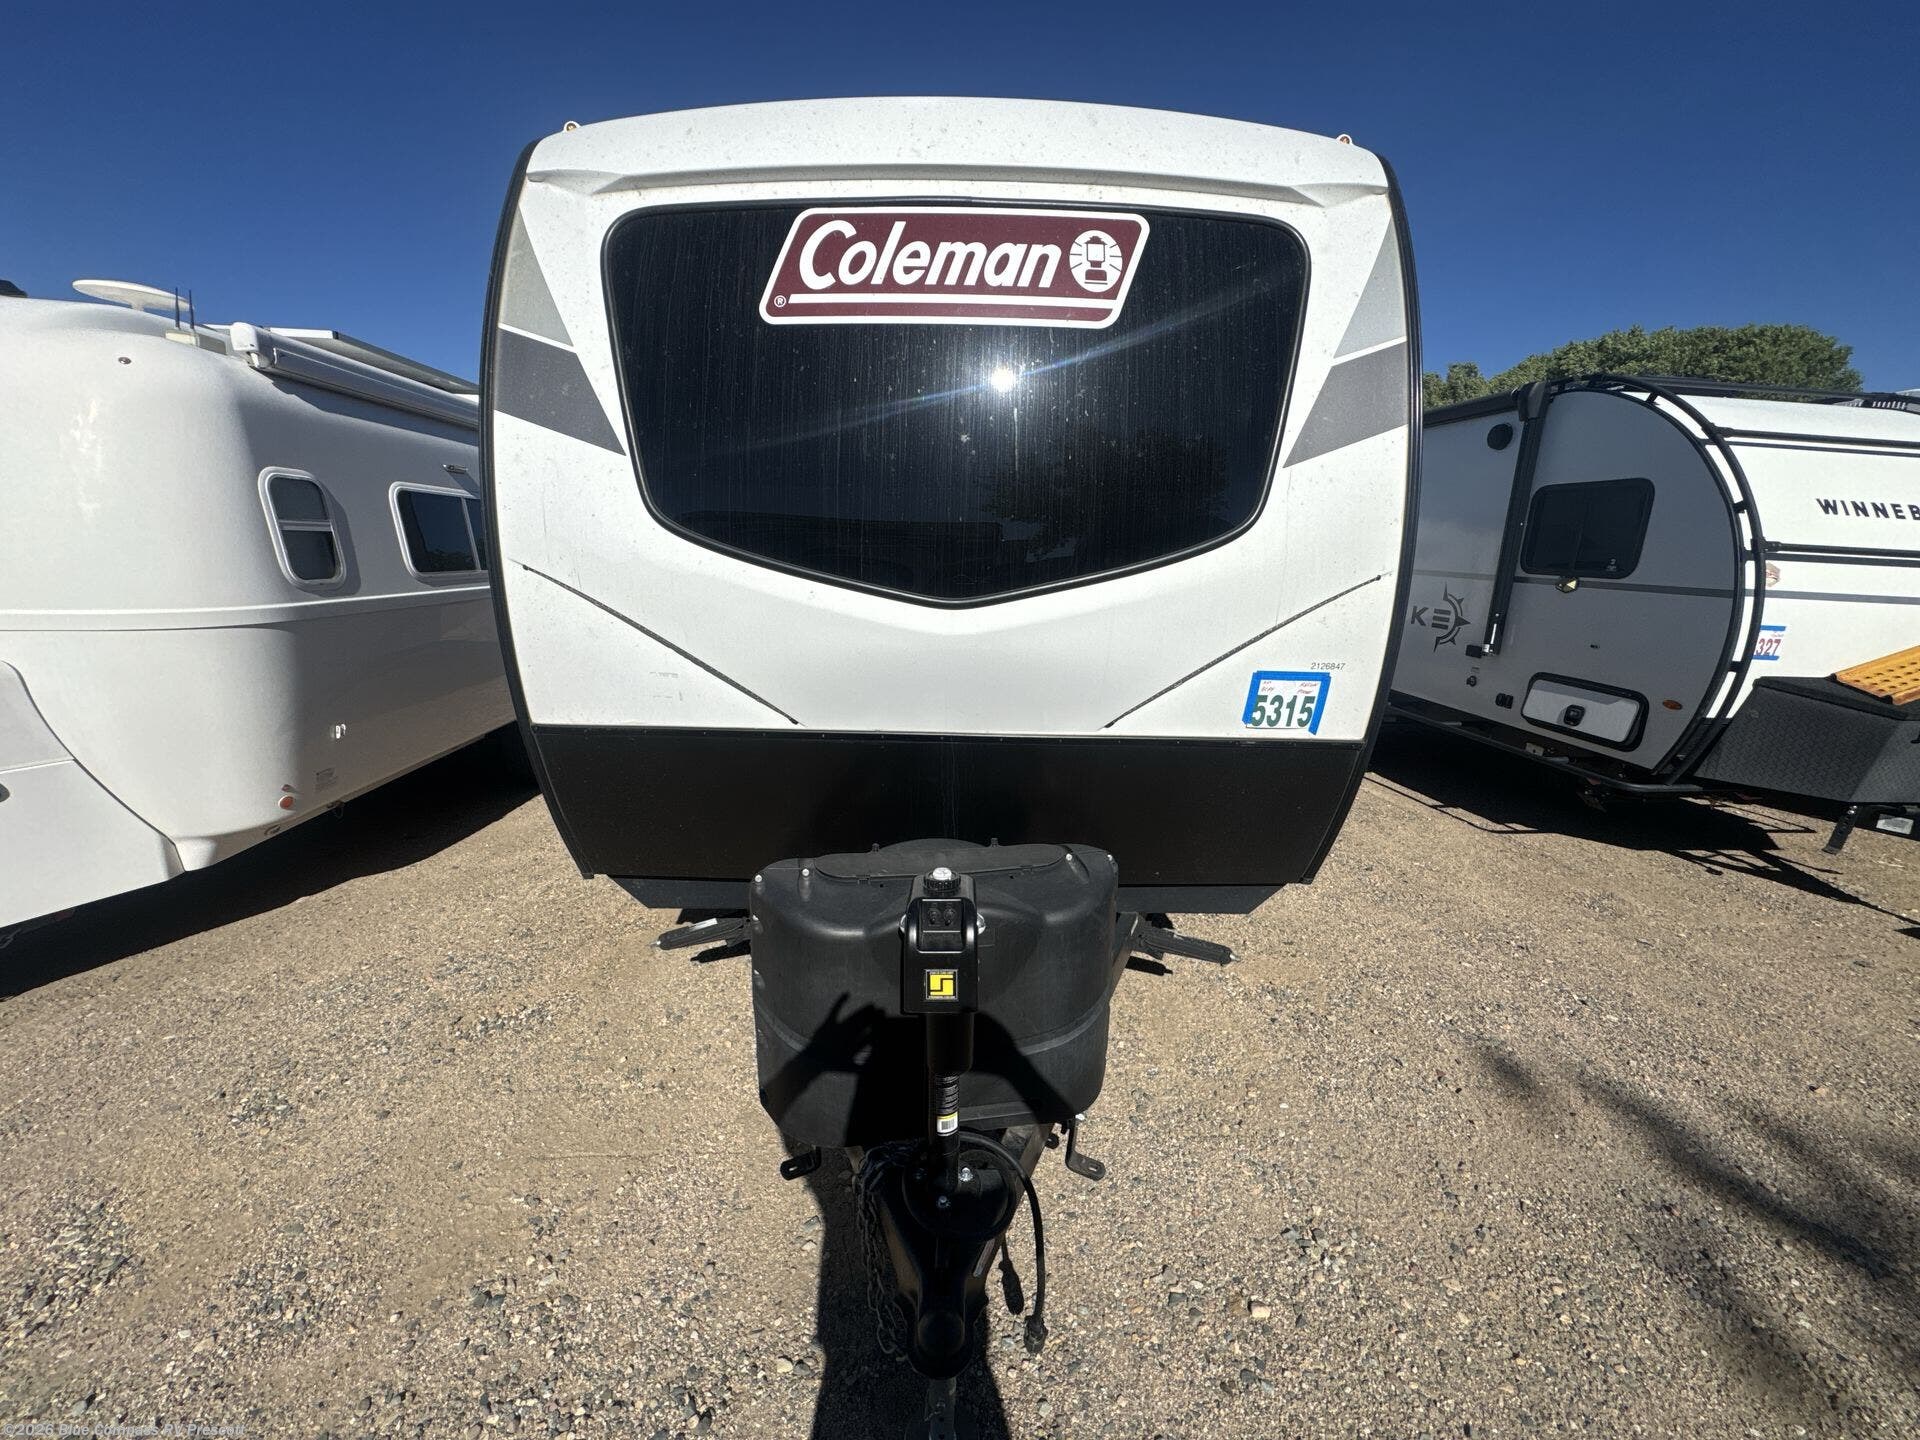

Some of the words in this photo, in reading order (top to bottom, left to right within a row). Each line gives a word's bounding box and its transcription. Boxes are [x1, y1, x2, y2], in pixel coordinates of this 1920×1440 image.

[800, 219, 1062, 290] Coleman
[1816, 498, 1920, 520] WINNEB
[1251, 695, 1316, 728] 5315
